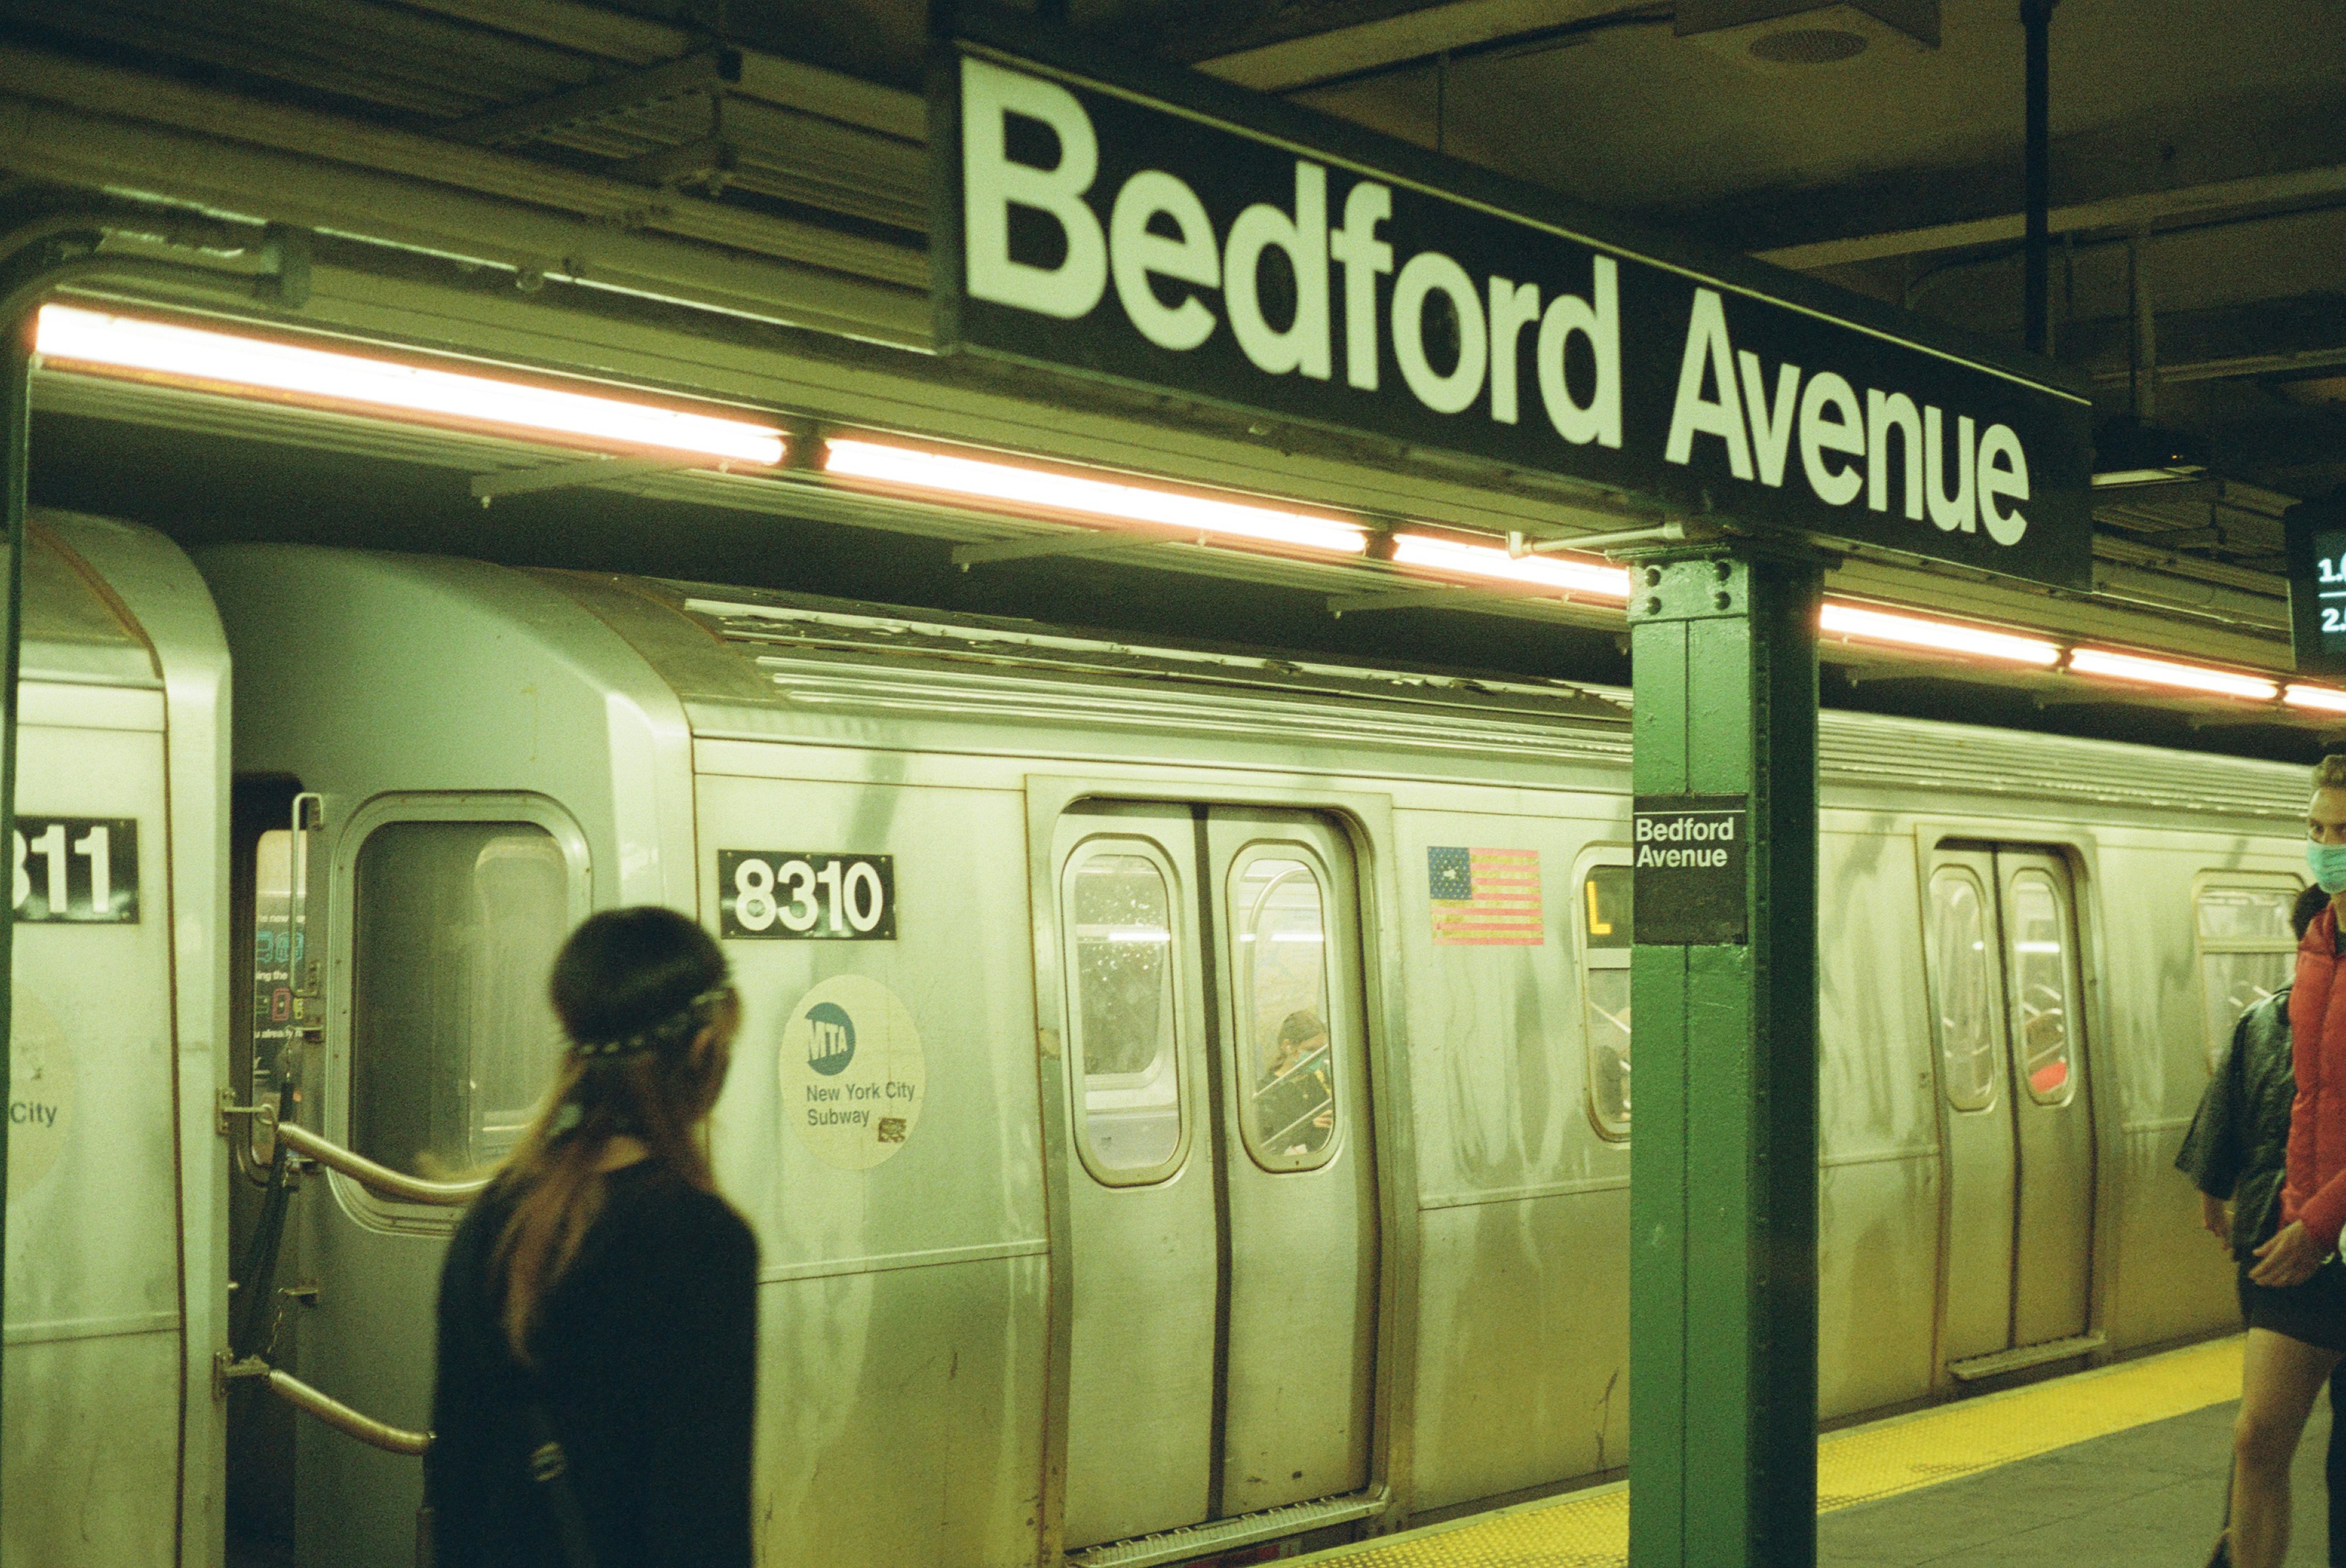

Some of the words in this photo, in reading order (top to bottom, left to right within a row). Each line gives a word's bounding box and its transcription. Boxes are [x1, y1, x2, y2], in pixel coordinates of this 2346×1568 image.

[961, 54, 1623, 450] Bedford
[1665, 287, 2030, 547] Avenue
[1636, 817, 1734, 842] Bedford
[1636, 845, 1727, 868] Avenue
[735, 858, 883, 932] 8310
[1587, 881, 1611, 935] L
[805, 1017, 850, 1062] MTA
[807, 1084, 840, 1102] New
[846, 1082, 881, 1101] York
[885, 1081, 915, 1102] City
[10, 1102, 58, 1128] City
[807, 1108, 870, 1127] Subway
